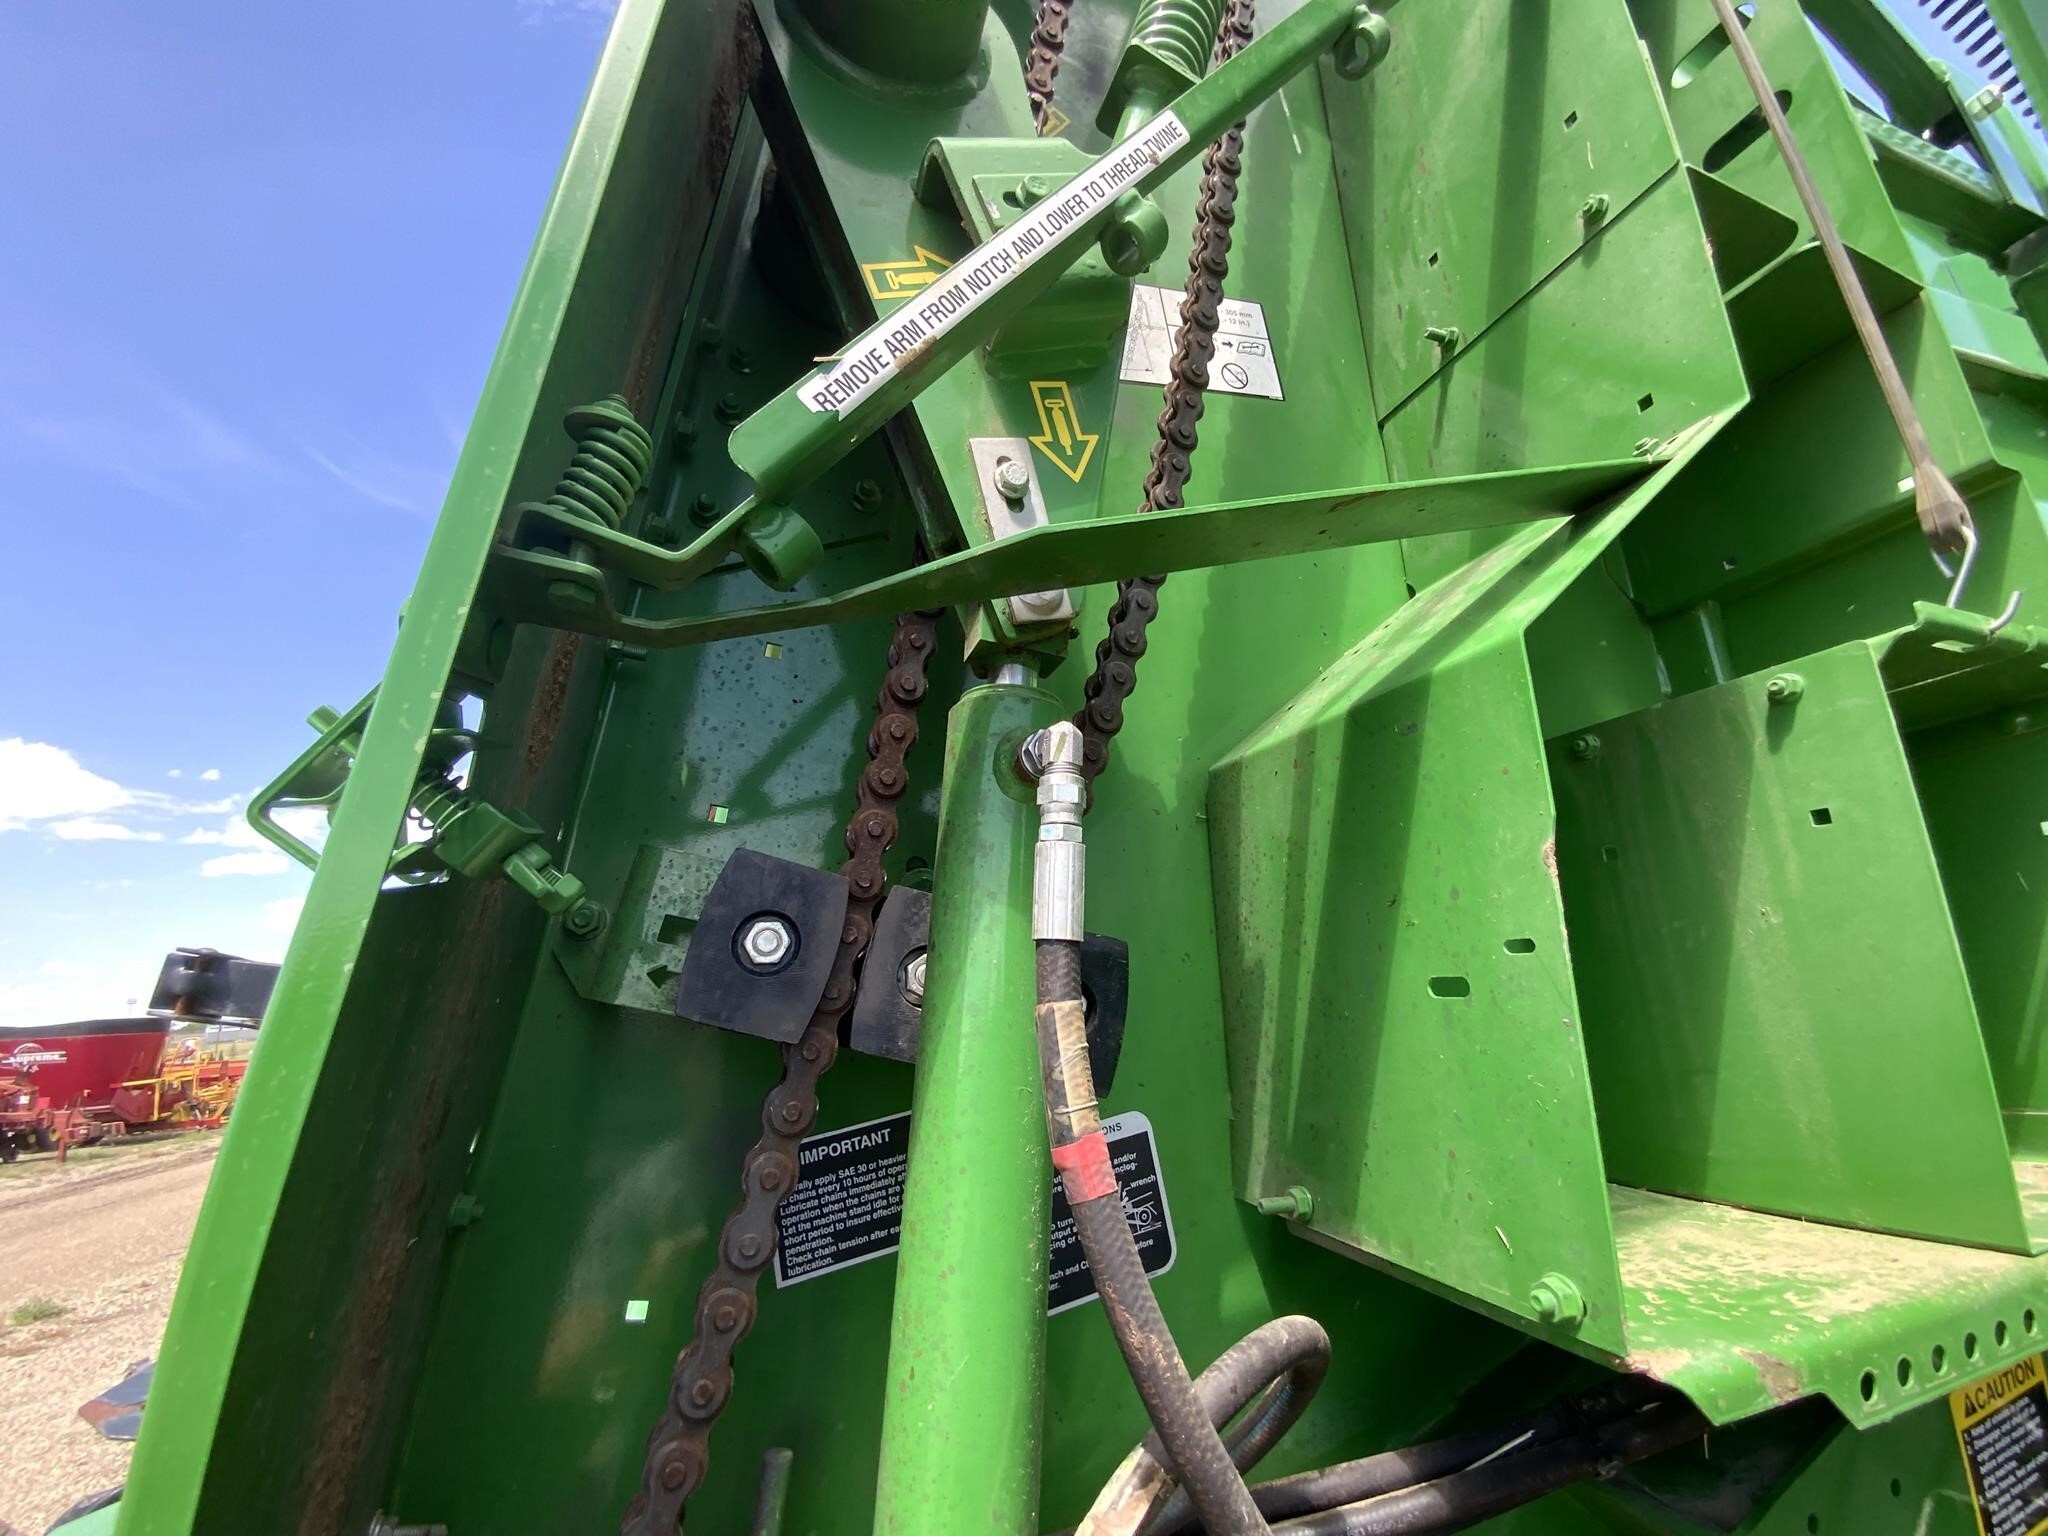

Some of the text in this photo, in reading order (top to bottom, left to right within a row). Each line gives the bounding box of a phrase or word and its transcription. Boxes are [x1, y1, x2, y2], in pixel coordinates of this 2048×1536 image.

[812, 121, 1182, 411] REMOVE ARM FROM NOTCH AND LOWER TO THREAD TWINE
[800, 1128, 891, 1166] IMPORTANT
[1113, 1152, 1137, 1165] and/or
[789, 1189, 817, 1203] chains
[818, 1182, 841, 1195] every
[843, 1177, 852, 1188] 10
[853, 1172, 877, 1184] hours
[878, 1167, 886, 1177] of
[814, 1173, 837, 1187] apply
[838, 1166, 856, 1179] SAE
[857, 1163, 868, 1174] 30
[868, 1161, 877, 1170] or
[878, 1153, 906, 1167] heavier
[1114, 1162, 1138, 1175] nclog-
[1130, 1174, 1156, 1188] wrench
[780, 1199, 819, 1216] Lubricate
[820, 1190, 848, 1204] chains
[849, 1176, 896, 1196] immediately
[781, 1209, 821, 1226] operation
[822, 1202, 845, 1214] when
[846, 1197, 859, 1207] the
[860, 1189, 887, 1203] chains
[887, 1185, 901, 1195] are
[782, 1195, 900, 1236] Let the machine stand idle for
[784, 1233, 807, 1247] short
[808, 1223, 835, 1241] period
[835, 1222, 845, 1231] to
[846, 1214, 872, 1228] insure
[785, 1236, 834, 1258] penetration.
[786, 1251, 814, 1267] Check
[814, 1244, 838, 1258] chain
[838, 1235, 869, 1251] tension
[870, 1229, 889, 1240] after
[1065, 1263, 1080, 1274] and
[1136, 1238, 1154, 1251] efore
[1067, 1235, 1077, 1245] or
[787, 1256, 835, 1277] lubrication.
[1974, 1358, 2036, 1410] CAUTION
